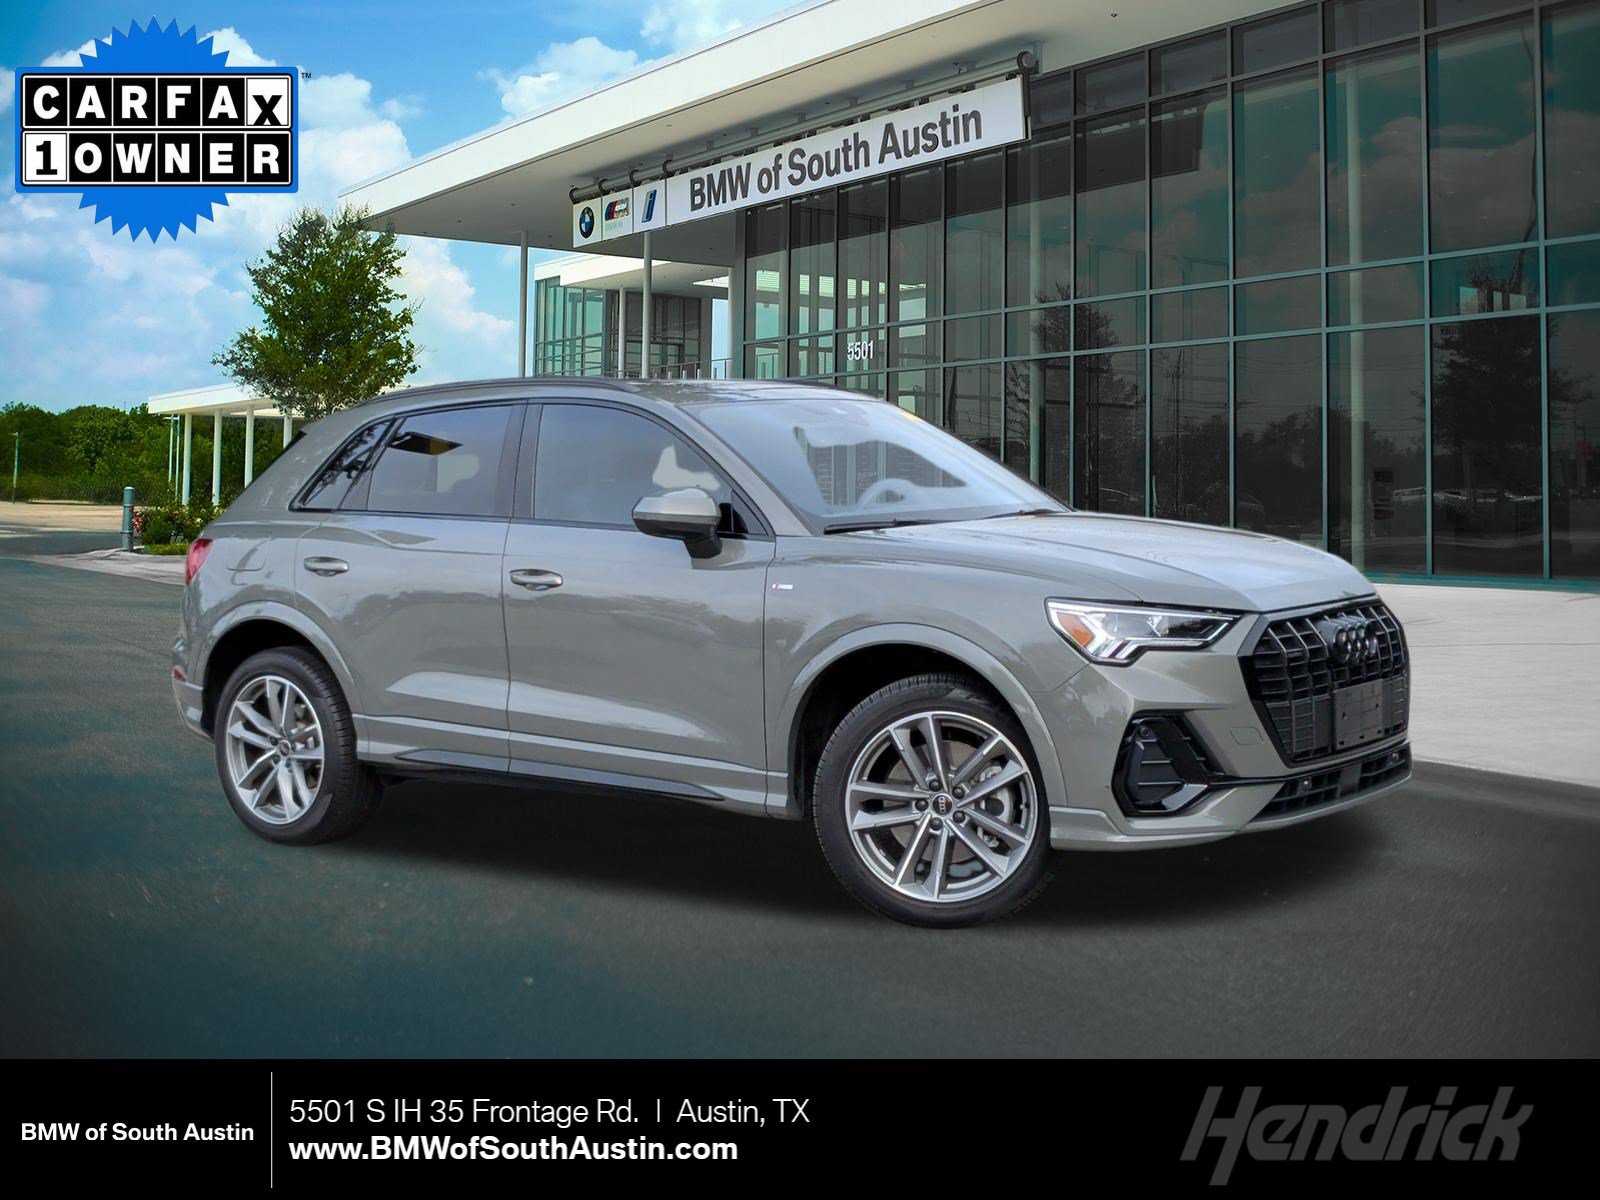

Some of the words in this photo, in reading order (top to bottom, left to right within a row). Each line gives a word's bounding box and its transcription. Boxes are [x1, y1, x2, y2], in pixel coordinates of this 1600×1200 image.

[690, 162, 752, 212] BMW
[757, 153, 783, 194] of
[787, 131, 870, 187] South
[878, 103, 982, 165] Austin
[847, 340, 874, 361] 5501
